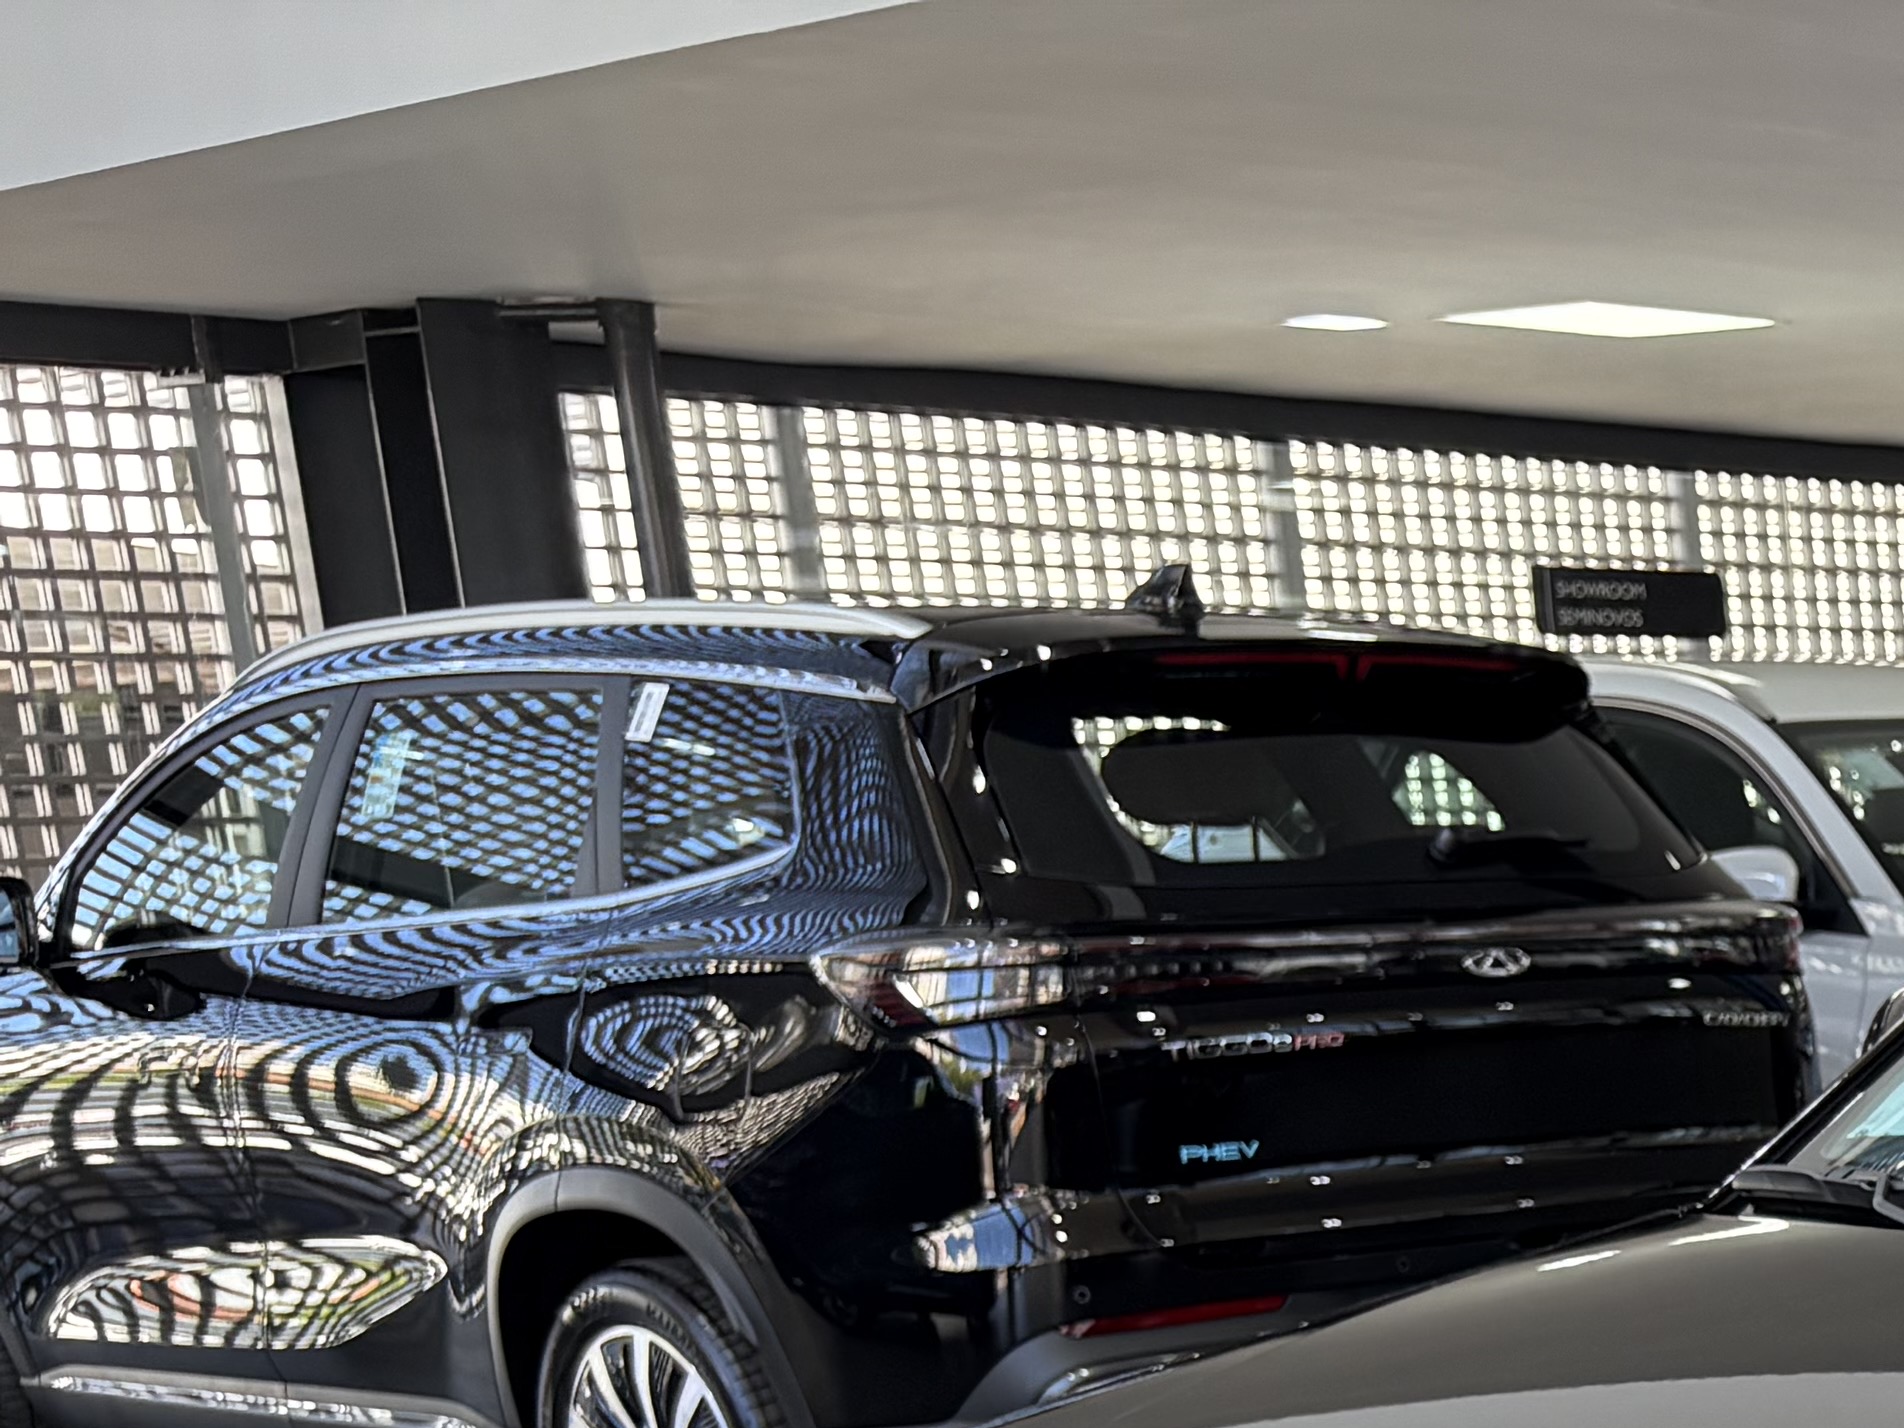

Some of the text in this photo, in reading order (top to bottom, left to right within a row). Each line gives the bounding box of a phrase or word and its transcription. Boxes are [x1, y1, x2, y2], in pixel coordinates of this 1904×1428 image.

[1554, 580, 1647, 600] SHOWROOM
[1557, 608, 1645, 627] SEMINOVOS
[1179, 1139, 1260, 1165] PHEV
